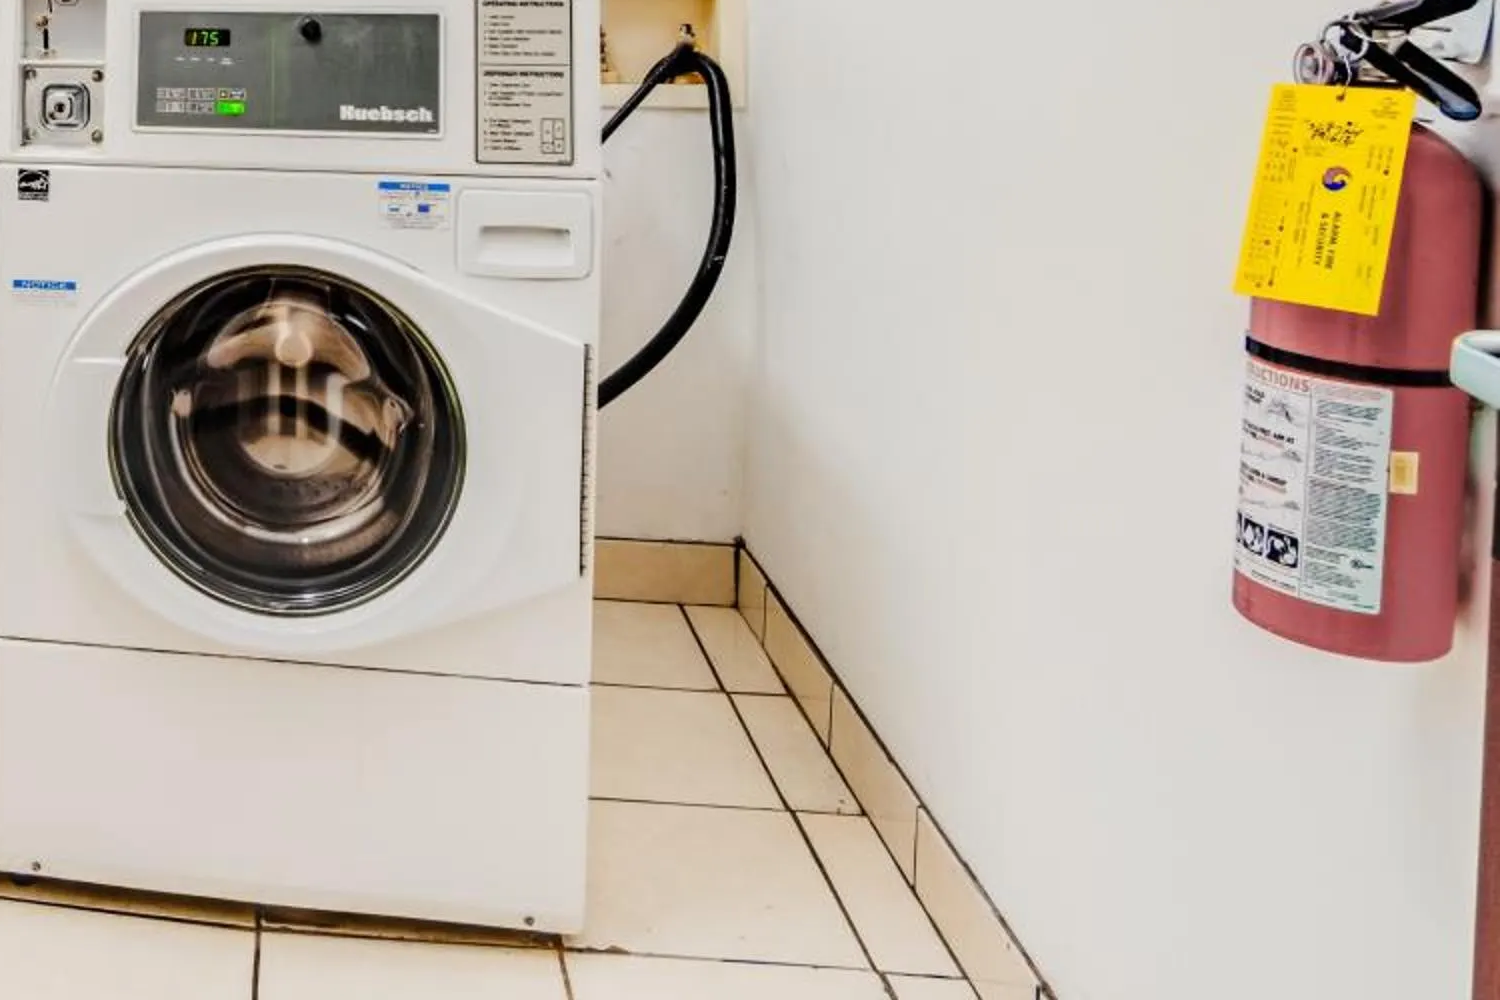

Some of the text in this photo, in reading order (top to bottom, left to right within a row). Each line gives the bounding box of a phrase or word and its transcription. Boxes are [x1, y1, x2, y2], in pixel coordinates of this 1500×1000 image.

[191, 31, 219, 45] 175
[340, 105, 434, 123] Huebsch
[20, 280, 66, 290] NOTICE
